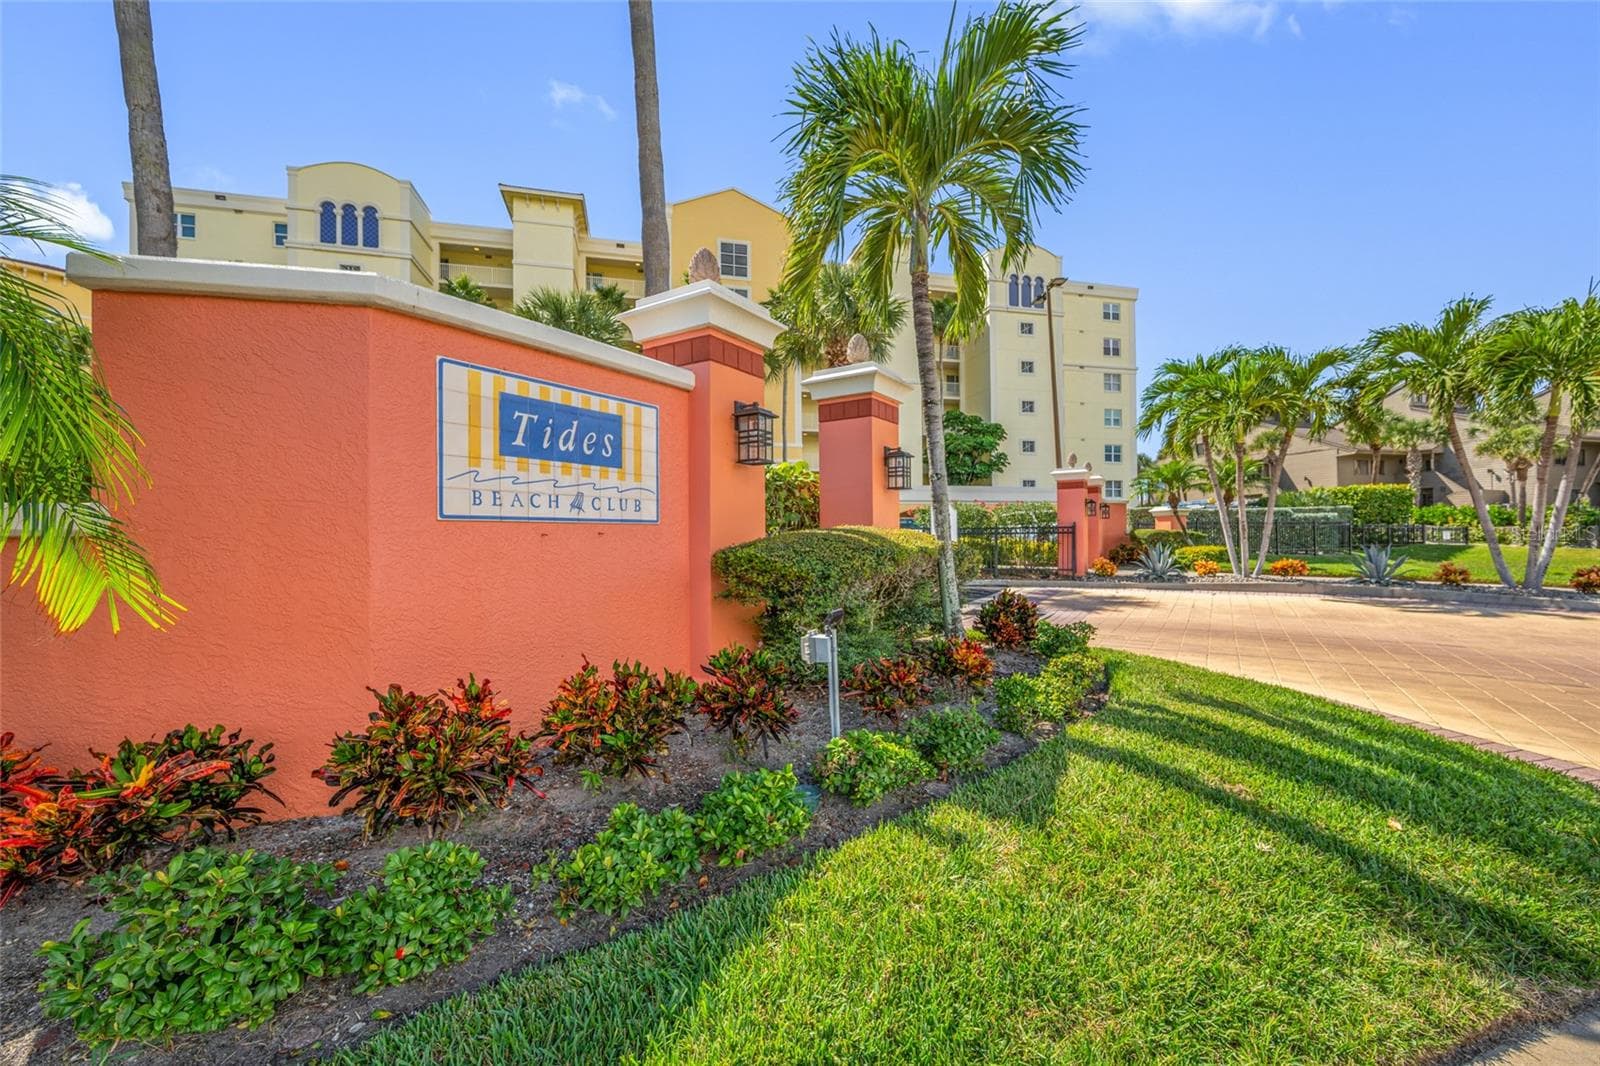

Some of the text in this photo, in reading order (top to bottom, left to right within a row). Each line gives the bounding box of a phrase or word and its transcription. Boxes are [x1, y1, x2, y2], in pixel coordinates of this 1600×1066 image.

[511, 410, 614, 458] Tides
[471, 489, 642, 512] BEACH CLUB
